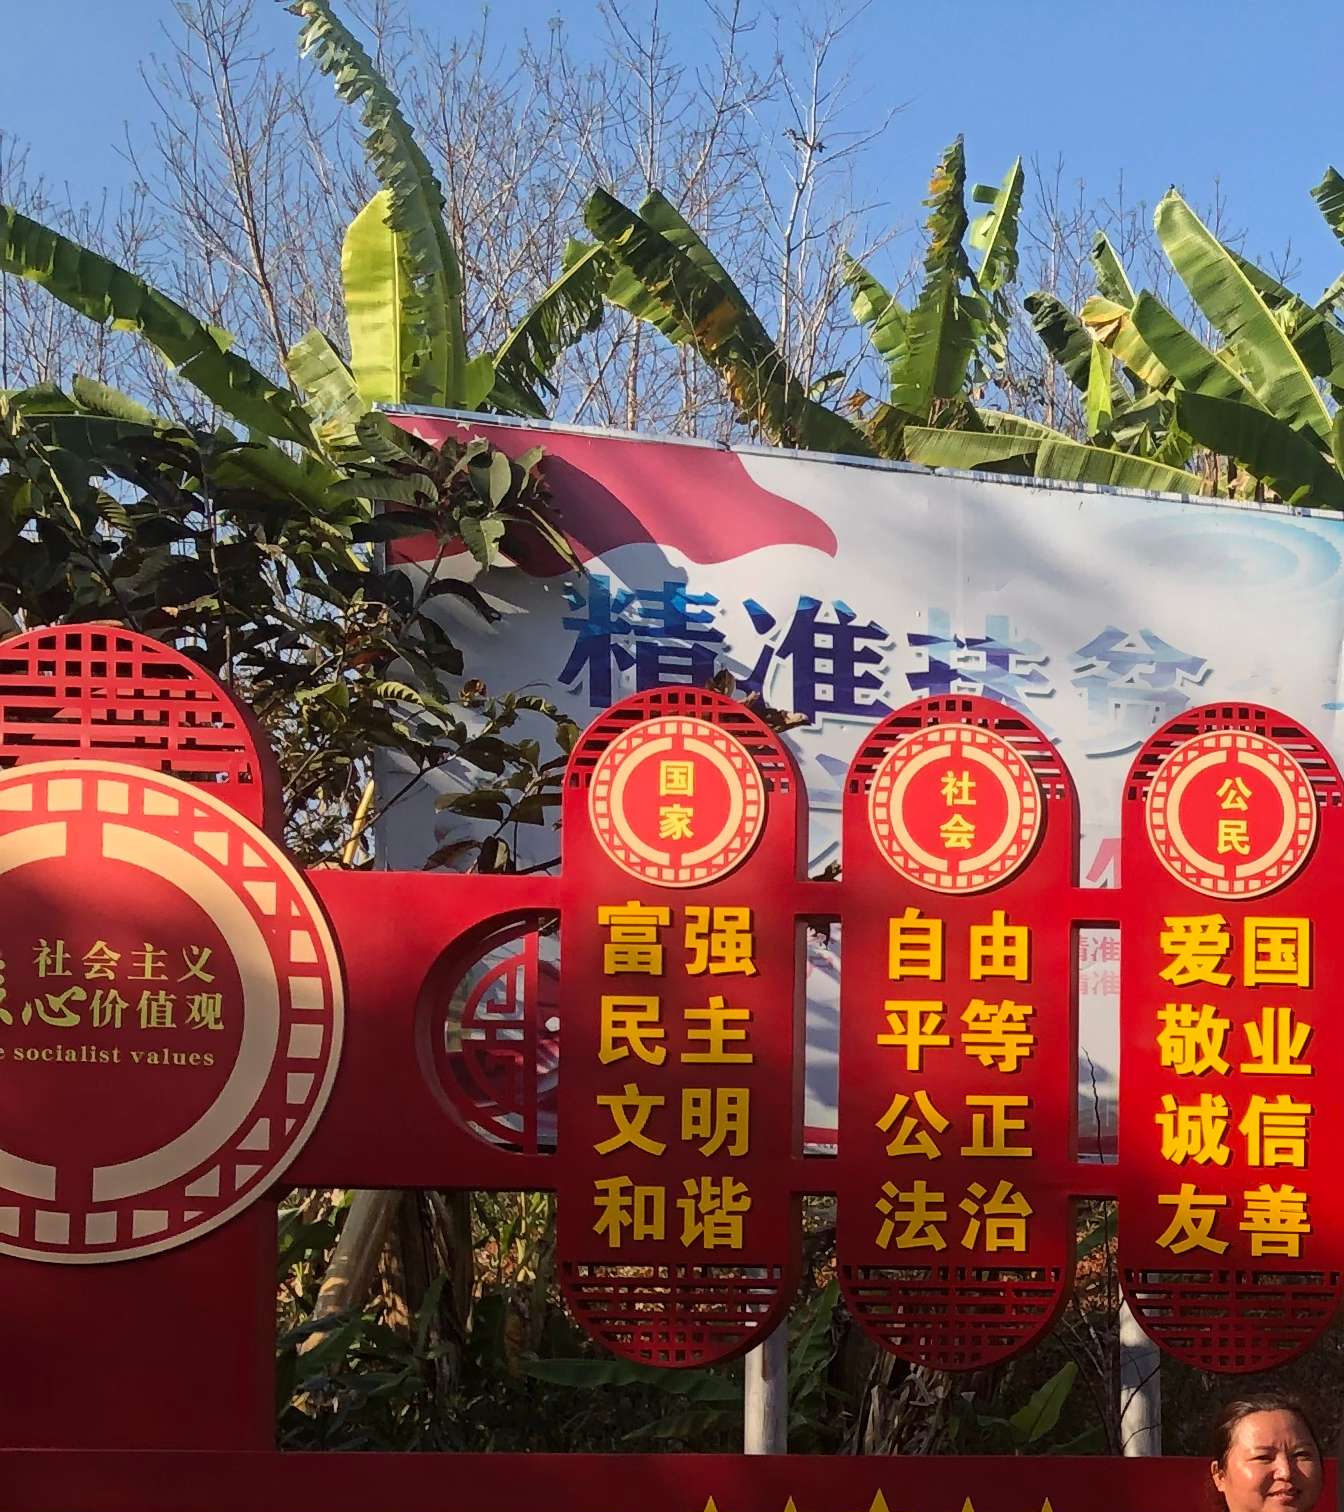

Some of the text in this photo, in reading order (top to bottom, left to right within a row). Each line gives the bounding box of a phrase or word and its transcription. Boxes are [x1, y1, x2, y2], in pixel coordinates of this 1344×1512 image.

[658, 759, 695, 841] 国家
[939, 770, 977, 850] 社会
[1216, 776, 1253, 855] 公民
[33, 939, 215, 983] 社会主义
[597, 900, 757, 976] 富强
[888, 907, 1029, 981] 自由
[1159, 913, 1310, 988] 爱国
[0, 966, 225, 1030] 心价值观
[598, 995, 754, 1066] 民主
[14, 1045, 120, 1063] socialist
[130, 1048, 215, 1066] values
[877, 999, 1034, 1072] 平等
[1156, 1003, 1312, 1076] 敬业
[594, 1082, 750, 1157] 文明
[876, 1090, 1033, 1160] 公正
[1155, 1093, 1312, 1167] 诚信
[593, 1175, 752, 1249] 和谐
[874, 1180, 1032, 1252] 法治
[1155, 1183, 1311, 1258] 友善
